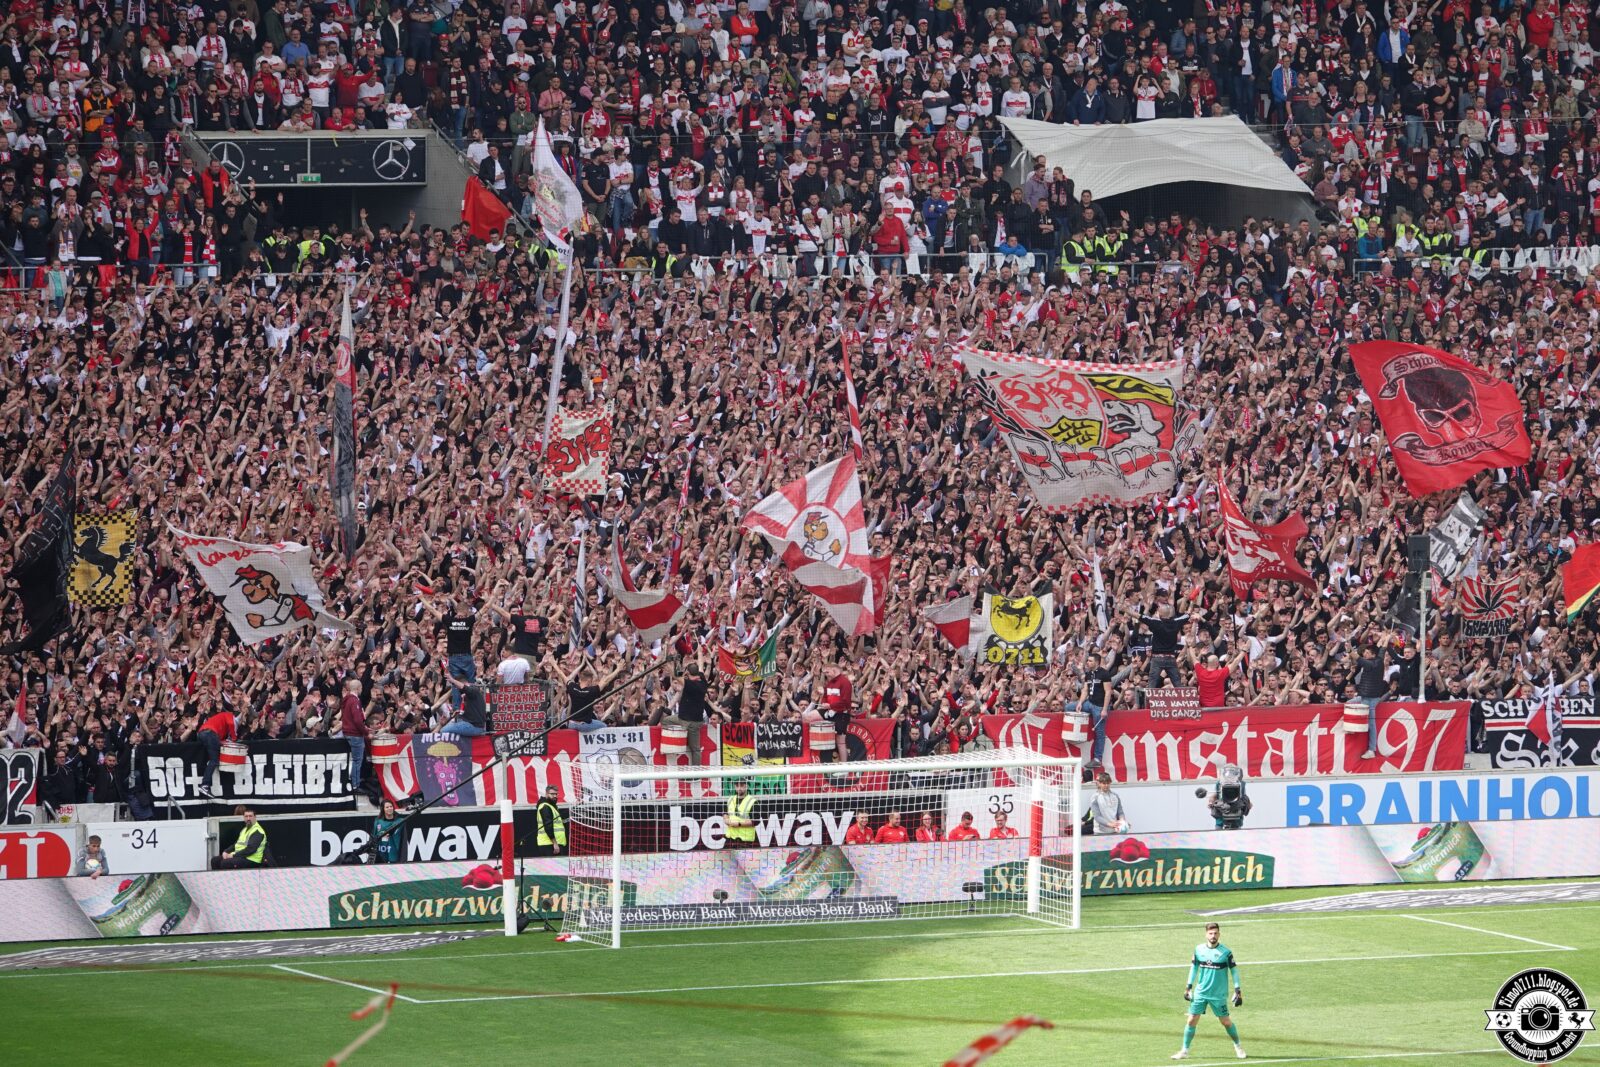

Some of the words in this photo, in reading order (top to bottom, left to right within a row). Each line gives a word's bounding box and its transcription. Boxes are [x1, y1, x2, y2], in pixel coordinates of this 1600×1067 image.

[987, 646, 1044, 665] 0711
[492, 691, 546, 704] VERBANNTE
[497, 684, 540, 693] JEDER
[497, 703, 541, 712] KEHRT
[1150, 709, 1170, 718] UMS
[507, 731, 521, 741] DU
[583, 733, 617, 745] WSB
[1377, 708, 1457, 773] 97
[523, 747, 545, 755] UNS!
[988, 794, 1014, 815] 35
[670, 805, 855, 851] beway
[131, 828, 159, 850] 34
[310, 819, 501, 866] beway
[591, 907, 697, 924] Mecedes-Benz
[701, 904, 737, 920] Bank
[749, 901, 854, 919] Mercedes-Benz
[858, 900, 895, 915] Bank
